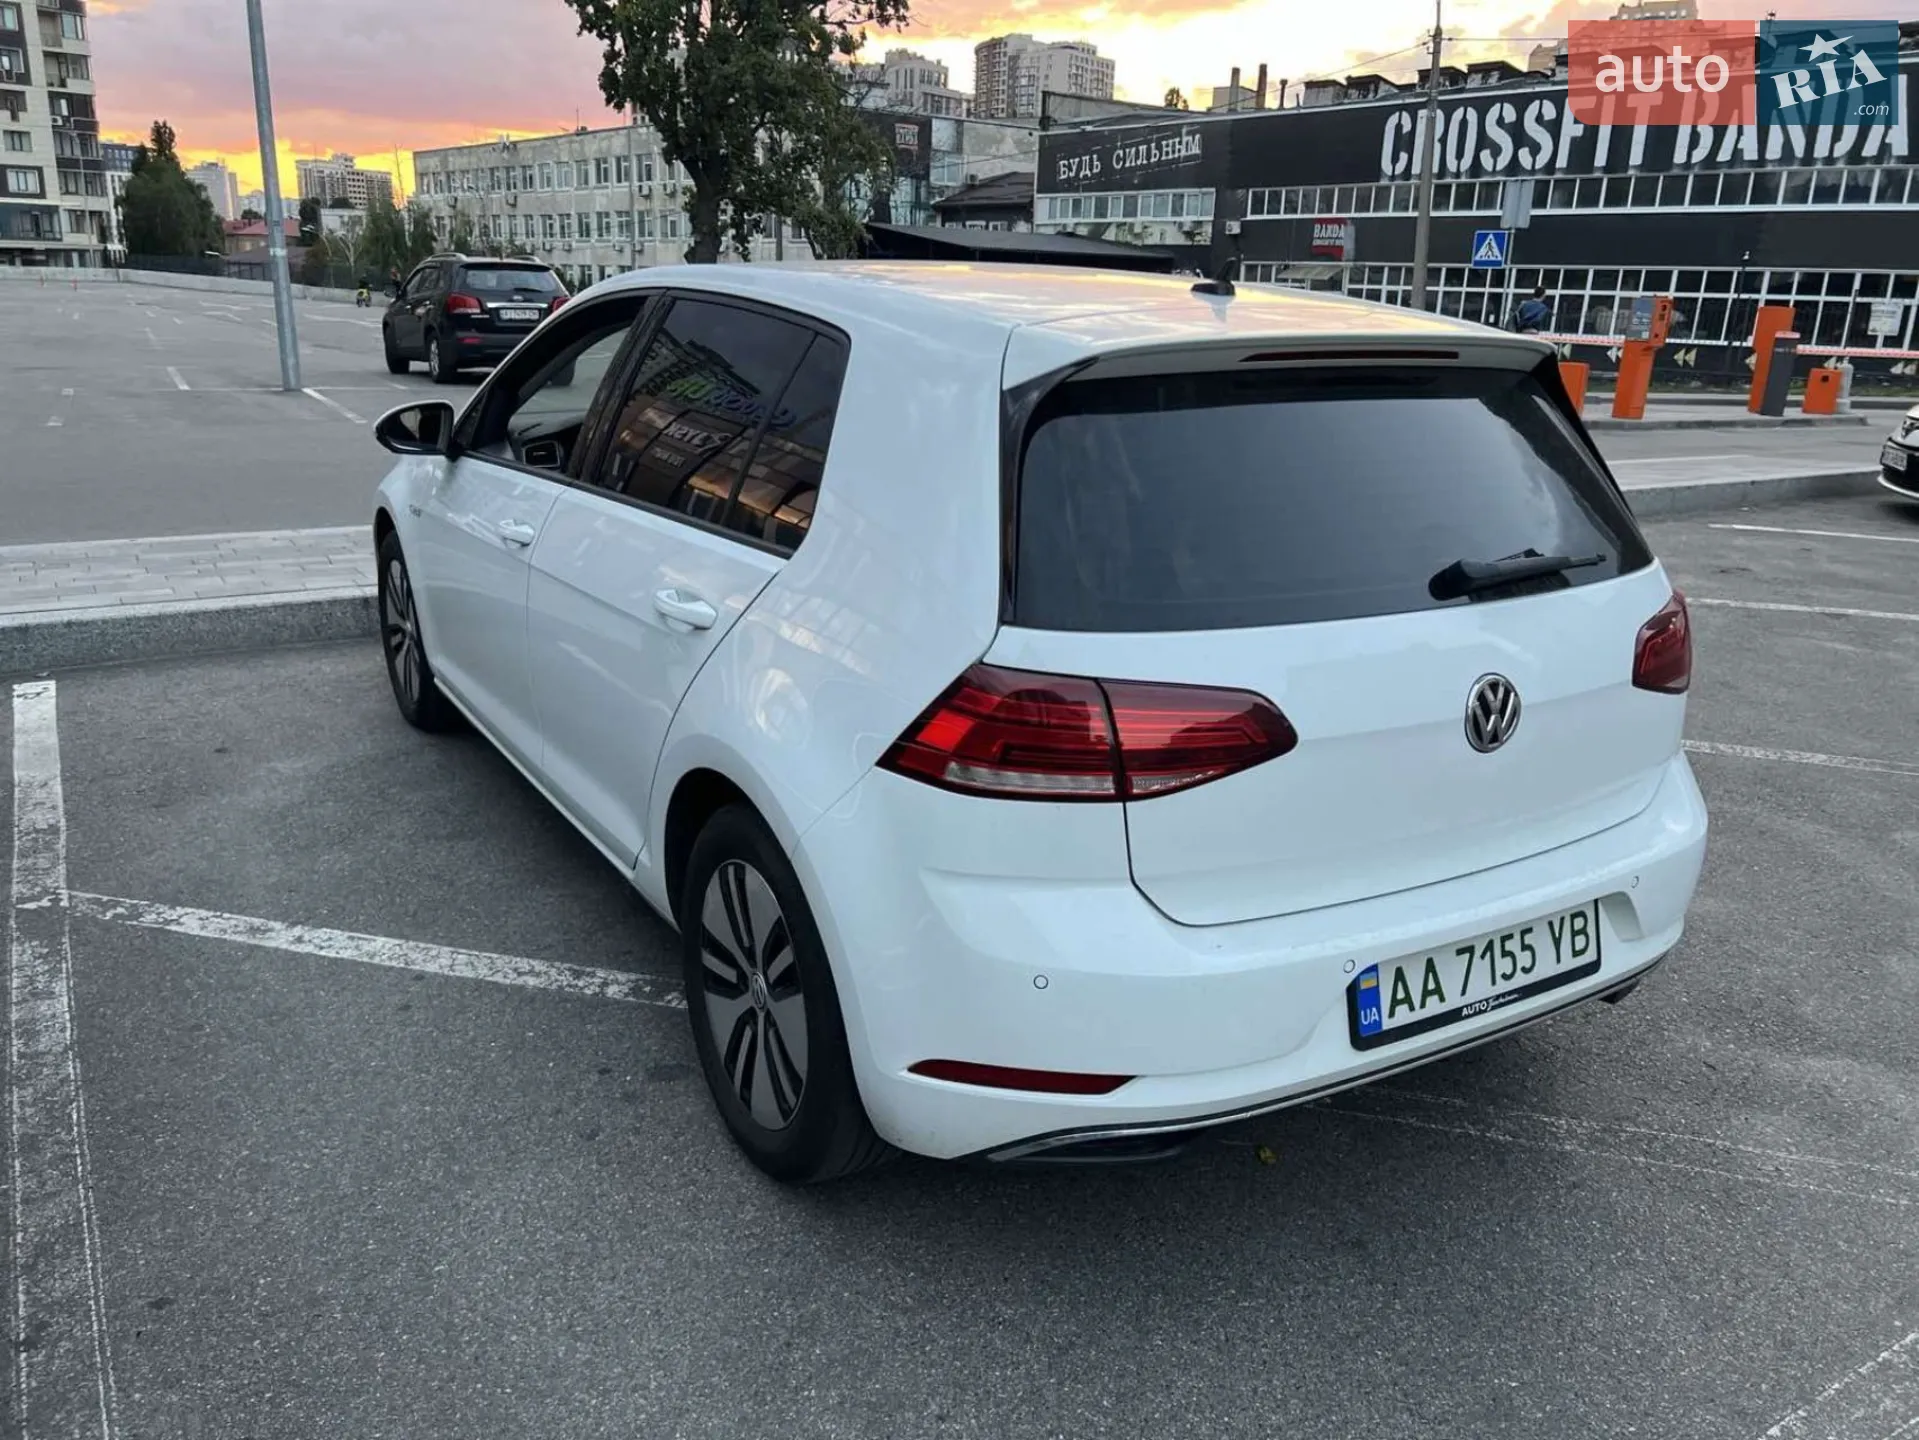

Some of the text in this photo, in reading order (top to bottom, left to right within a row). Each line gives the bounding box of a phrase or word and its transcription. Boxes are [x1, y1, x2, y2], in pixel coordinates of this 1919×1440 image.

[1381, 74, 1909, 176] CROSSFIT BANDA
[1058, 133, 1201, 180] БУДЬ СИЛЬНЫМ
[1387, 910, 1590, 1020] AA 7155 YB
[1361, 1006, 1380, 1025] UA
[1461, 1000, 1488, 1017] AUTO
